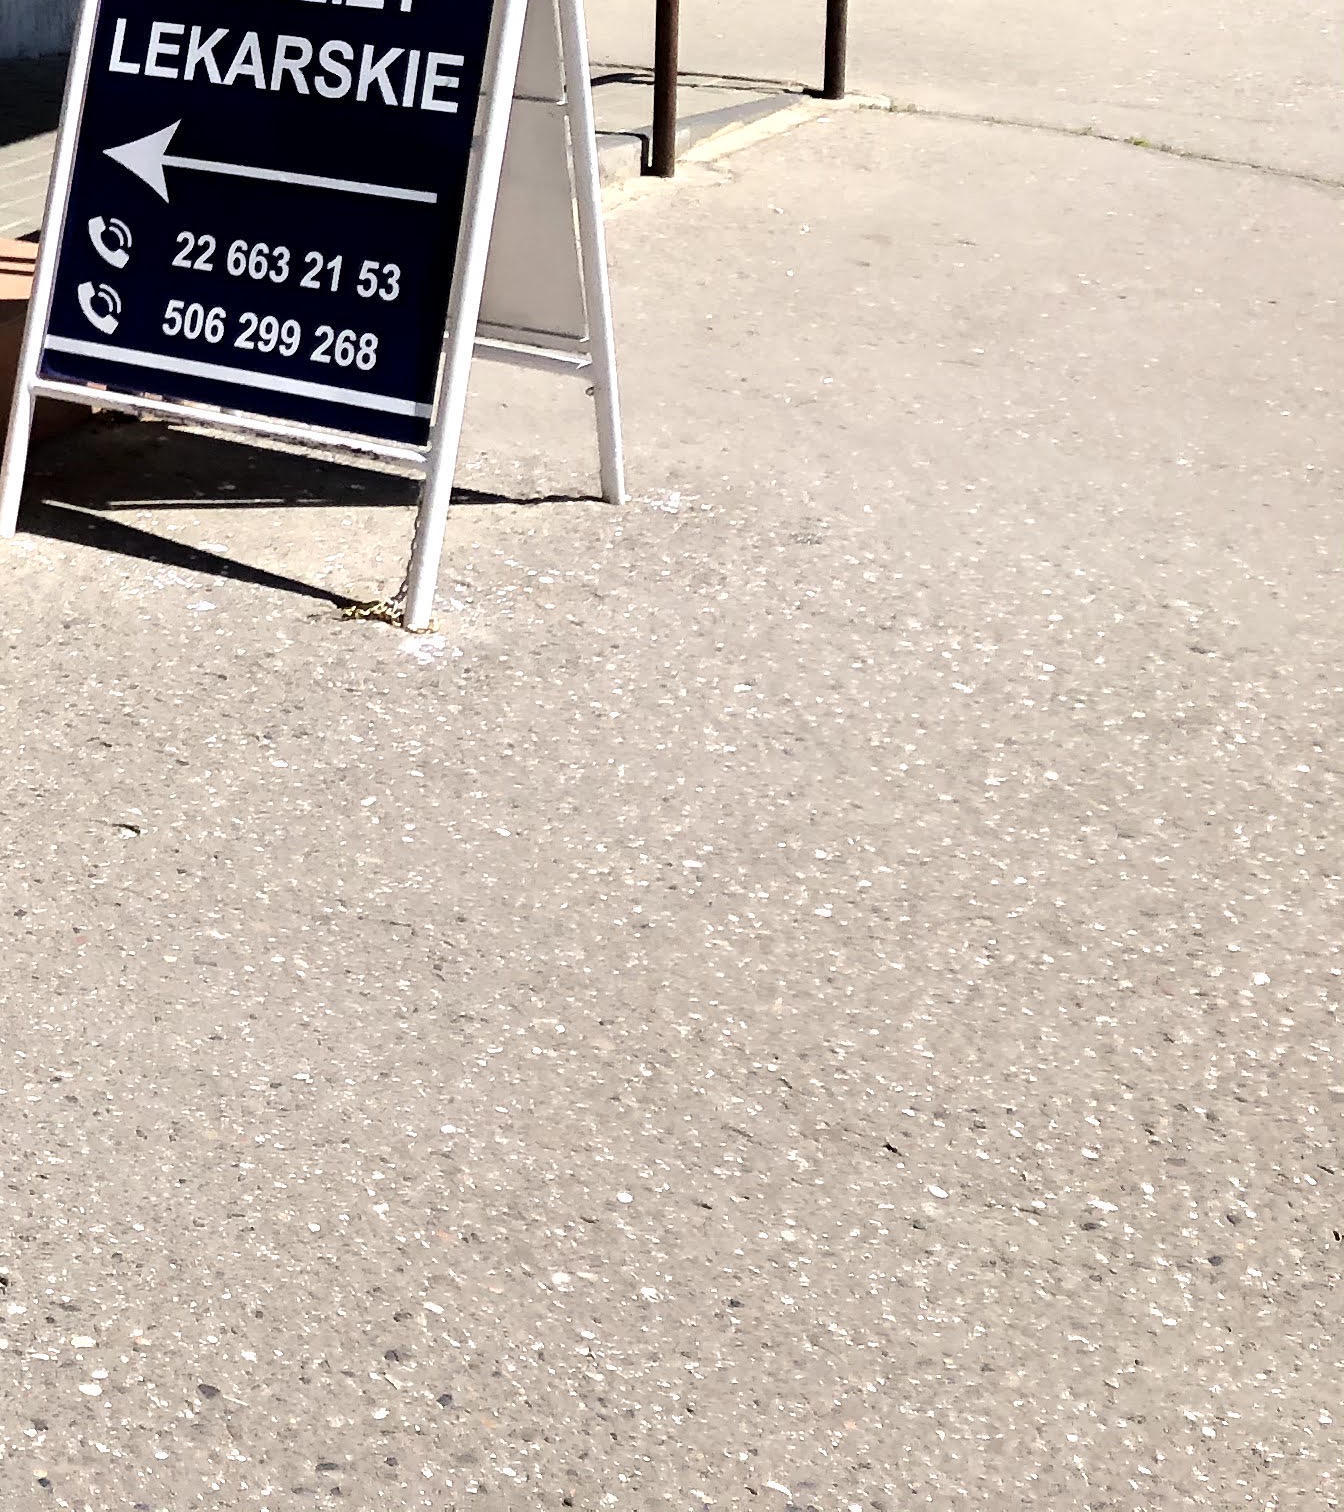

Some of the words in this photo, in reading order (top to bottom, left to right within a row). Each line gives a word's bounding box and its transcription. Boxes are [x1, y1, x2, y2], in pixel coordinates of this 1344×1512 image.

[107, 17, 467, 115] LEKARSKIE
[171, 230, 216, 272] 22
[225, 238, 291, 285] 663
[301, 251, 344, 295] 21
[355, 258, 403, 303] 53
[161, 298, 226, 344] 506
[235, 308, 302, 358] 299
[311, 320, 380, 372] 268
